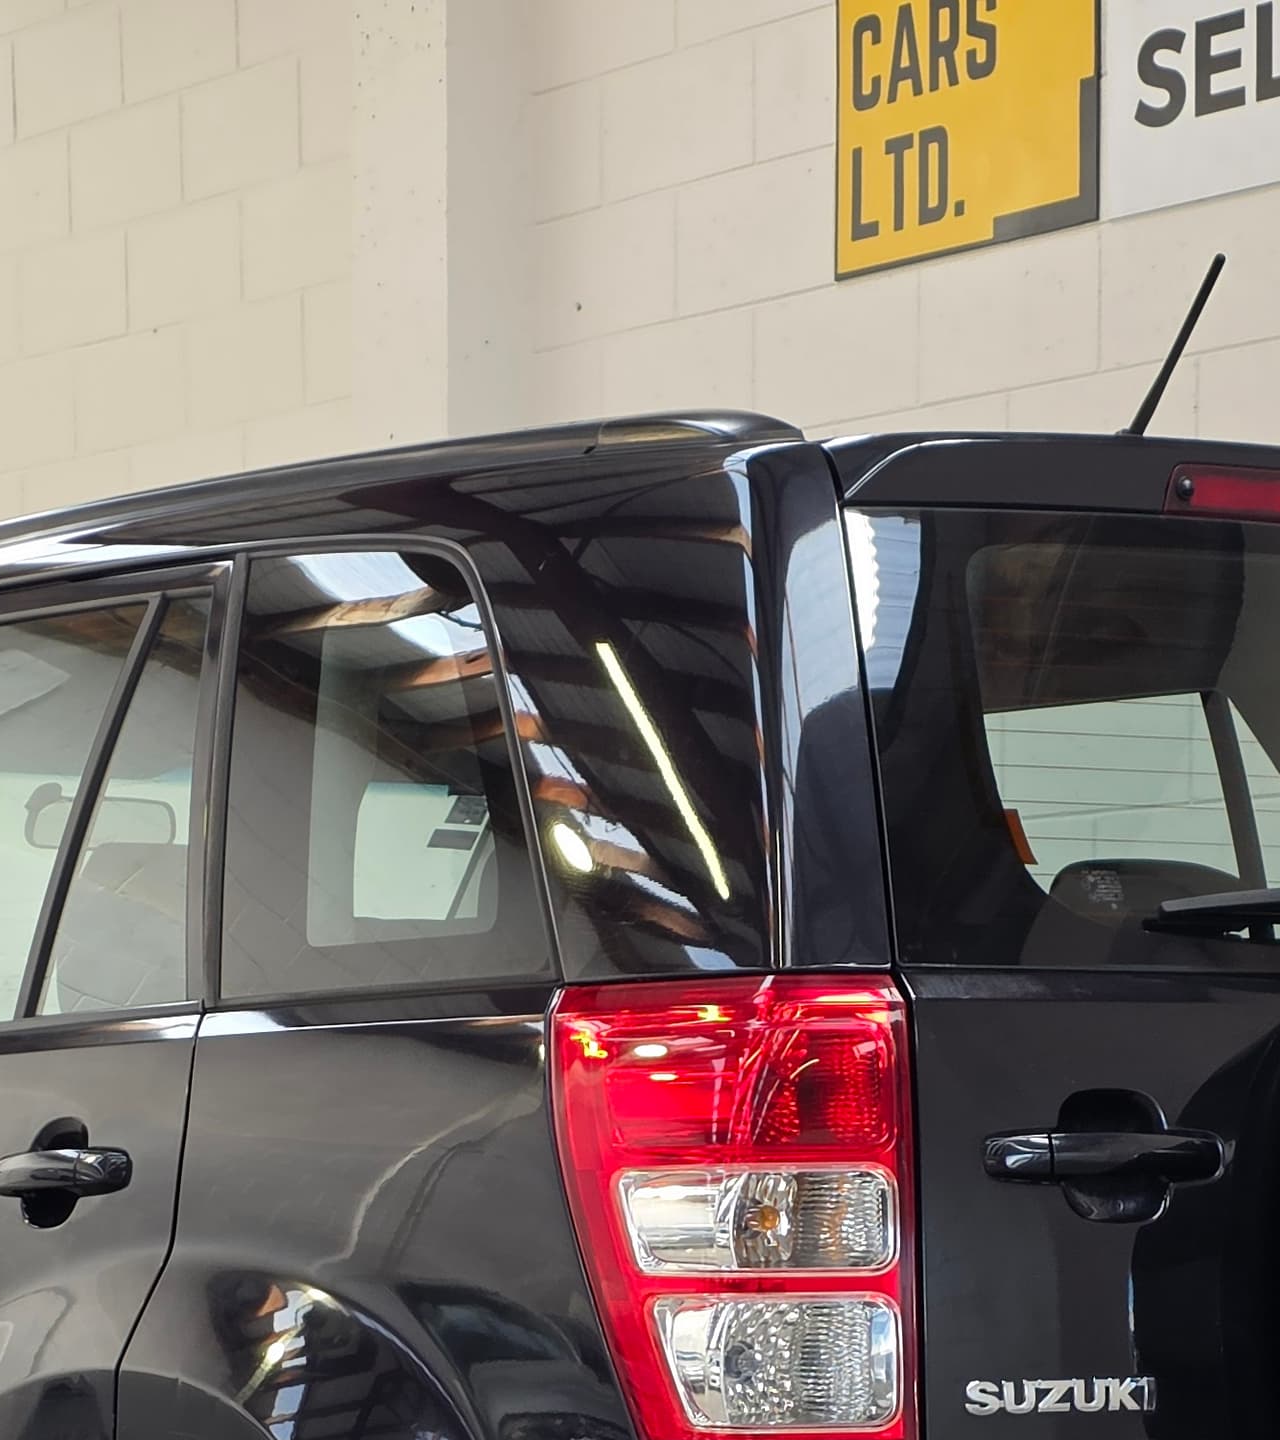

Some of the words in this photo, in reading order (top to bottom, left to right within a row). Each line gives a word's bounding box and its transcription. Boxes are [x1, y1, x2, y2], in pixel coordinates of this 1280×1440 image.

[852, 0, 998, 112] CARS
[851, 124, 966, 242] LTD.
[965, 1376, 1157, 1416] SUZUKI
